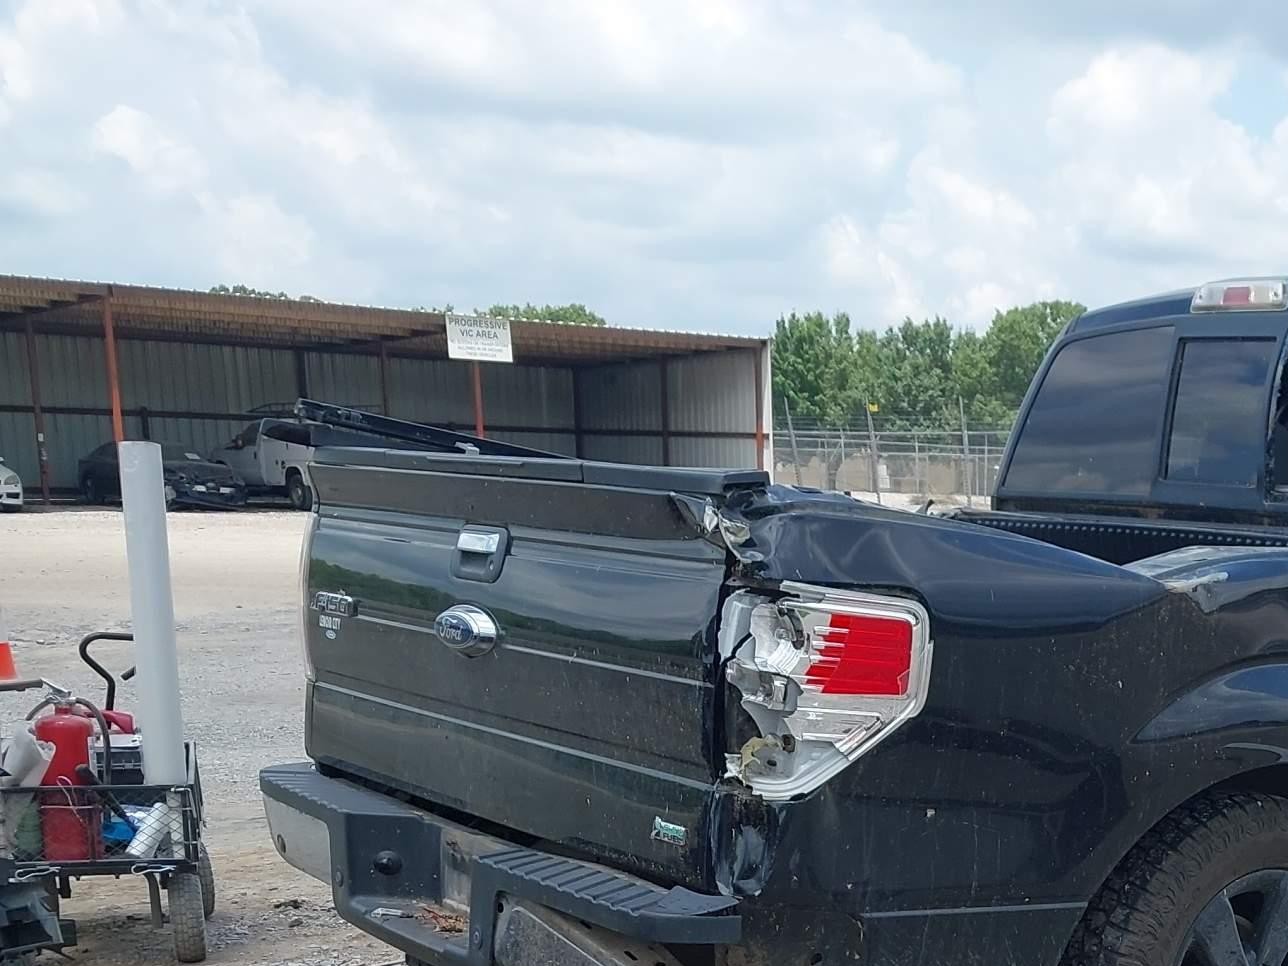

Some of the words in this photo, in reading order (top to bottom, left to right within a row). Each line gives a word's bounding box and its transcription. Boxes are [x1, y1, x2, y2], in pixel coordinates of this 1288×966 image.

[448, 317, 508, 330] PROGRESSIVE
[460, 329, 474, 337] VIC
[476, 330, 498, 339] AREA
[440, 616, 462, 640] Ford
